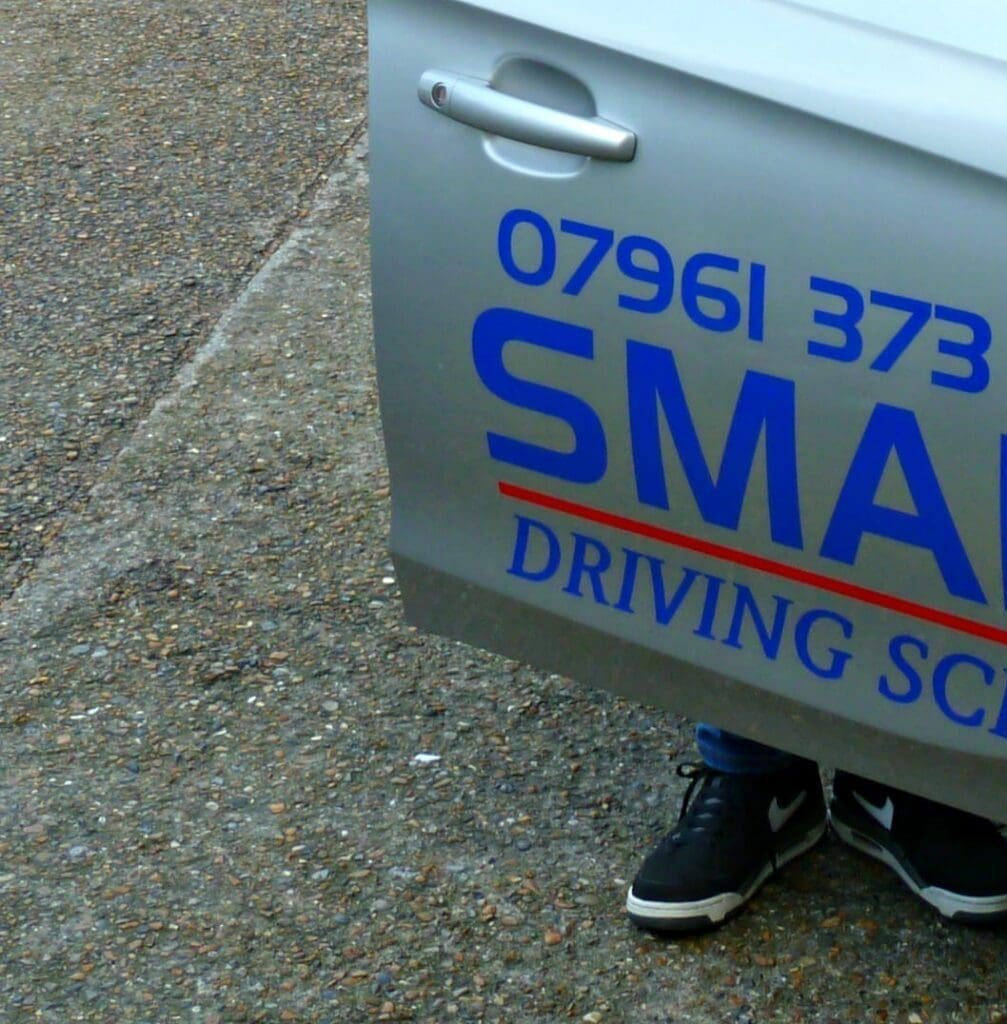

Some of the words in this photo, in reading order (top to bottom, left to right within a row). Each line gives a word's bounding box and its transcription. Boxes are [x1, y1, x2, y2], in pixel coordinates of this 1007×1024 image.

[495, 207, 768, 343] 07961
[806, 274, 993, 395] 373
[507, 515, 854, 681] DRIVING
